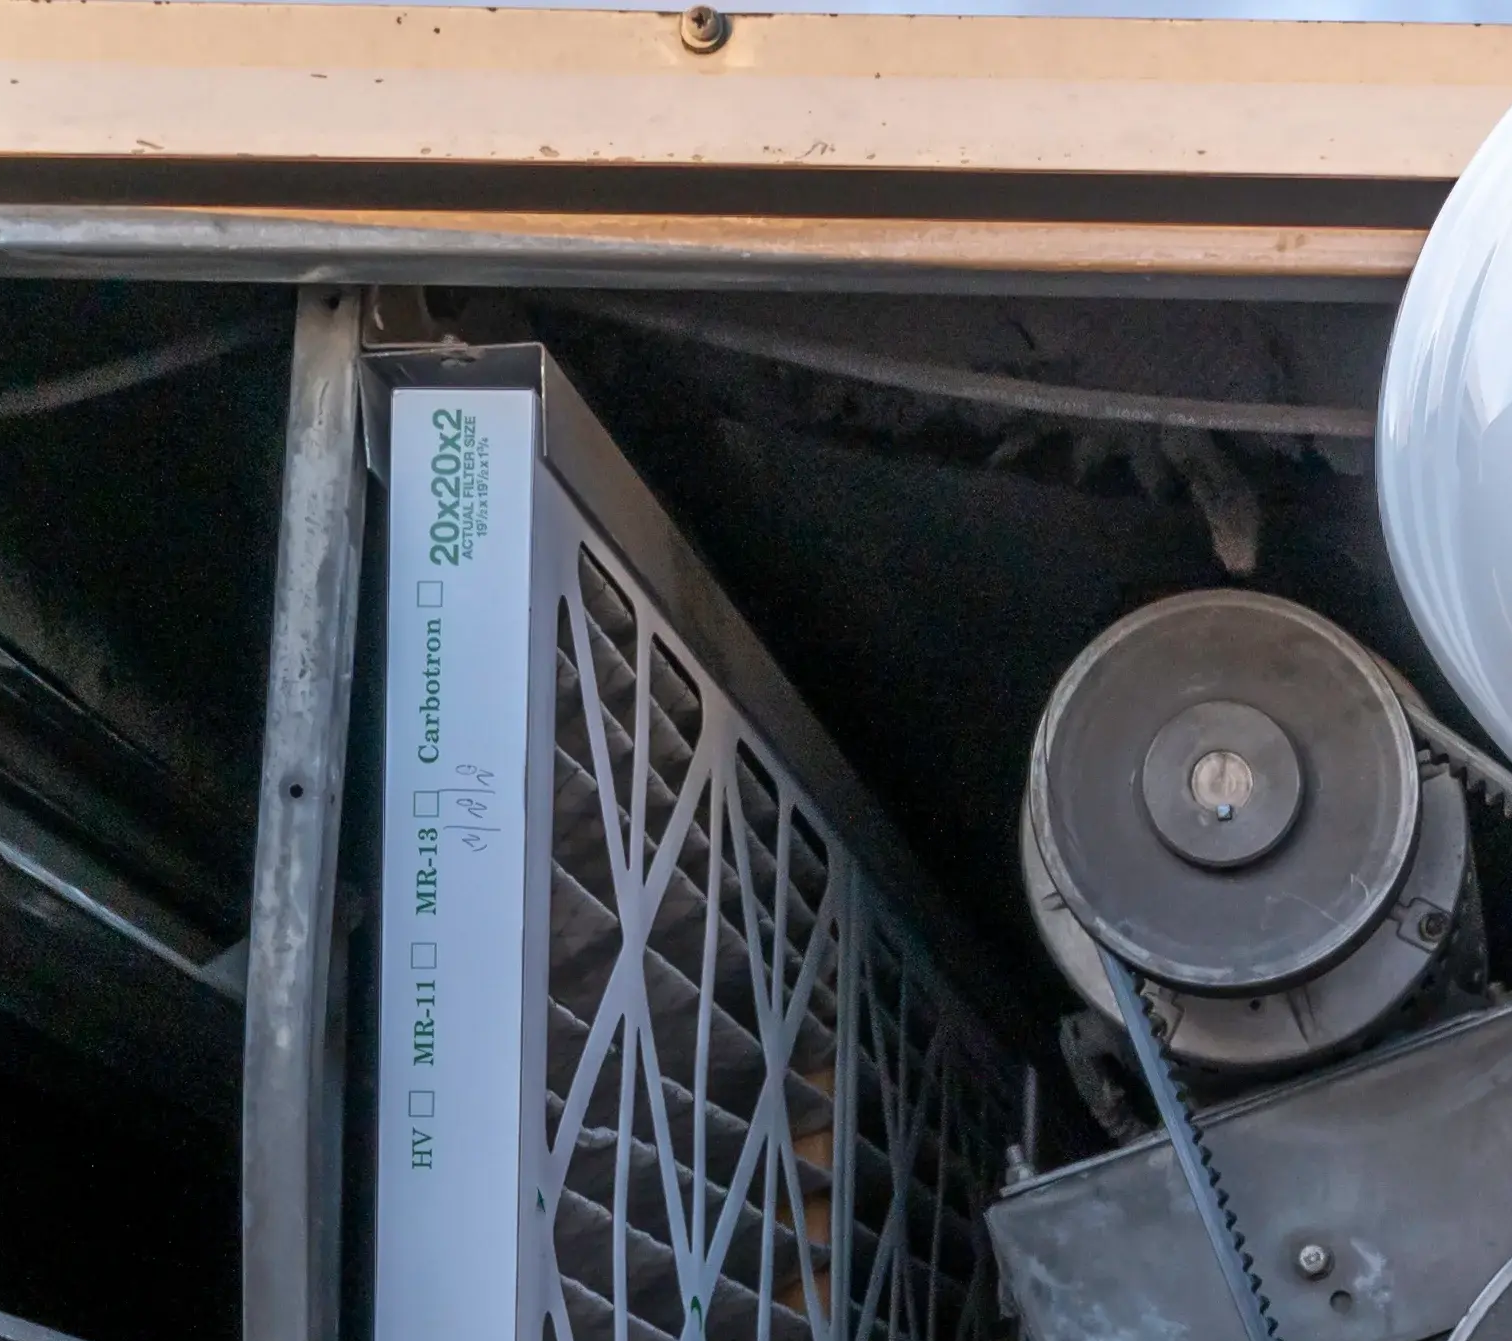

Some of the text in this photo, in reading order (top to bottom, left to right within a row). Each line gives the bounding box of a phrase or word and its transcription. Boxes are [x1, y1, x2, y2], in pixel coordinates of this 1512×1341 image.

[462, 417, 475, 560] ACTUAL FILTER SIZE
[412, 410, 463, 1169] HV MR-11 MR-13 Carbotron 20x20x2
